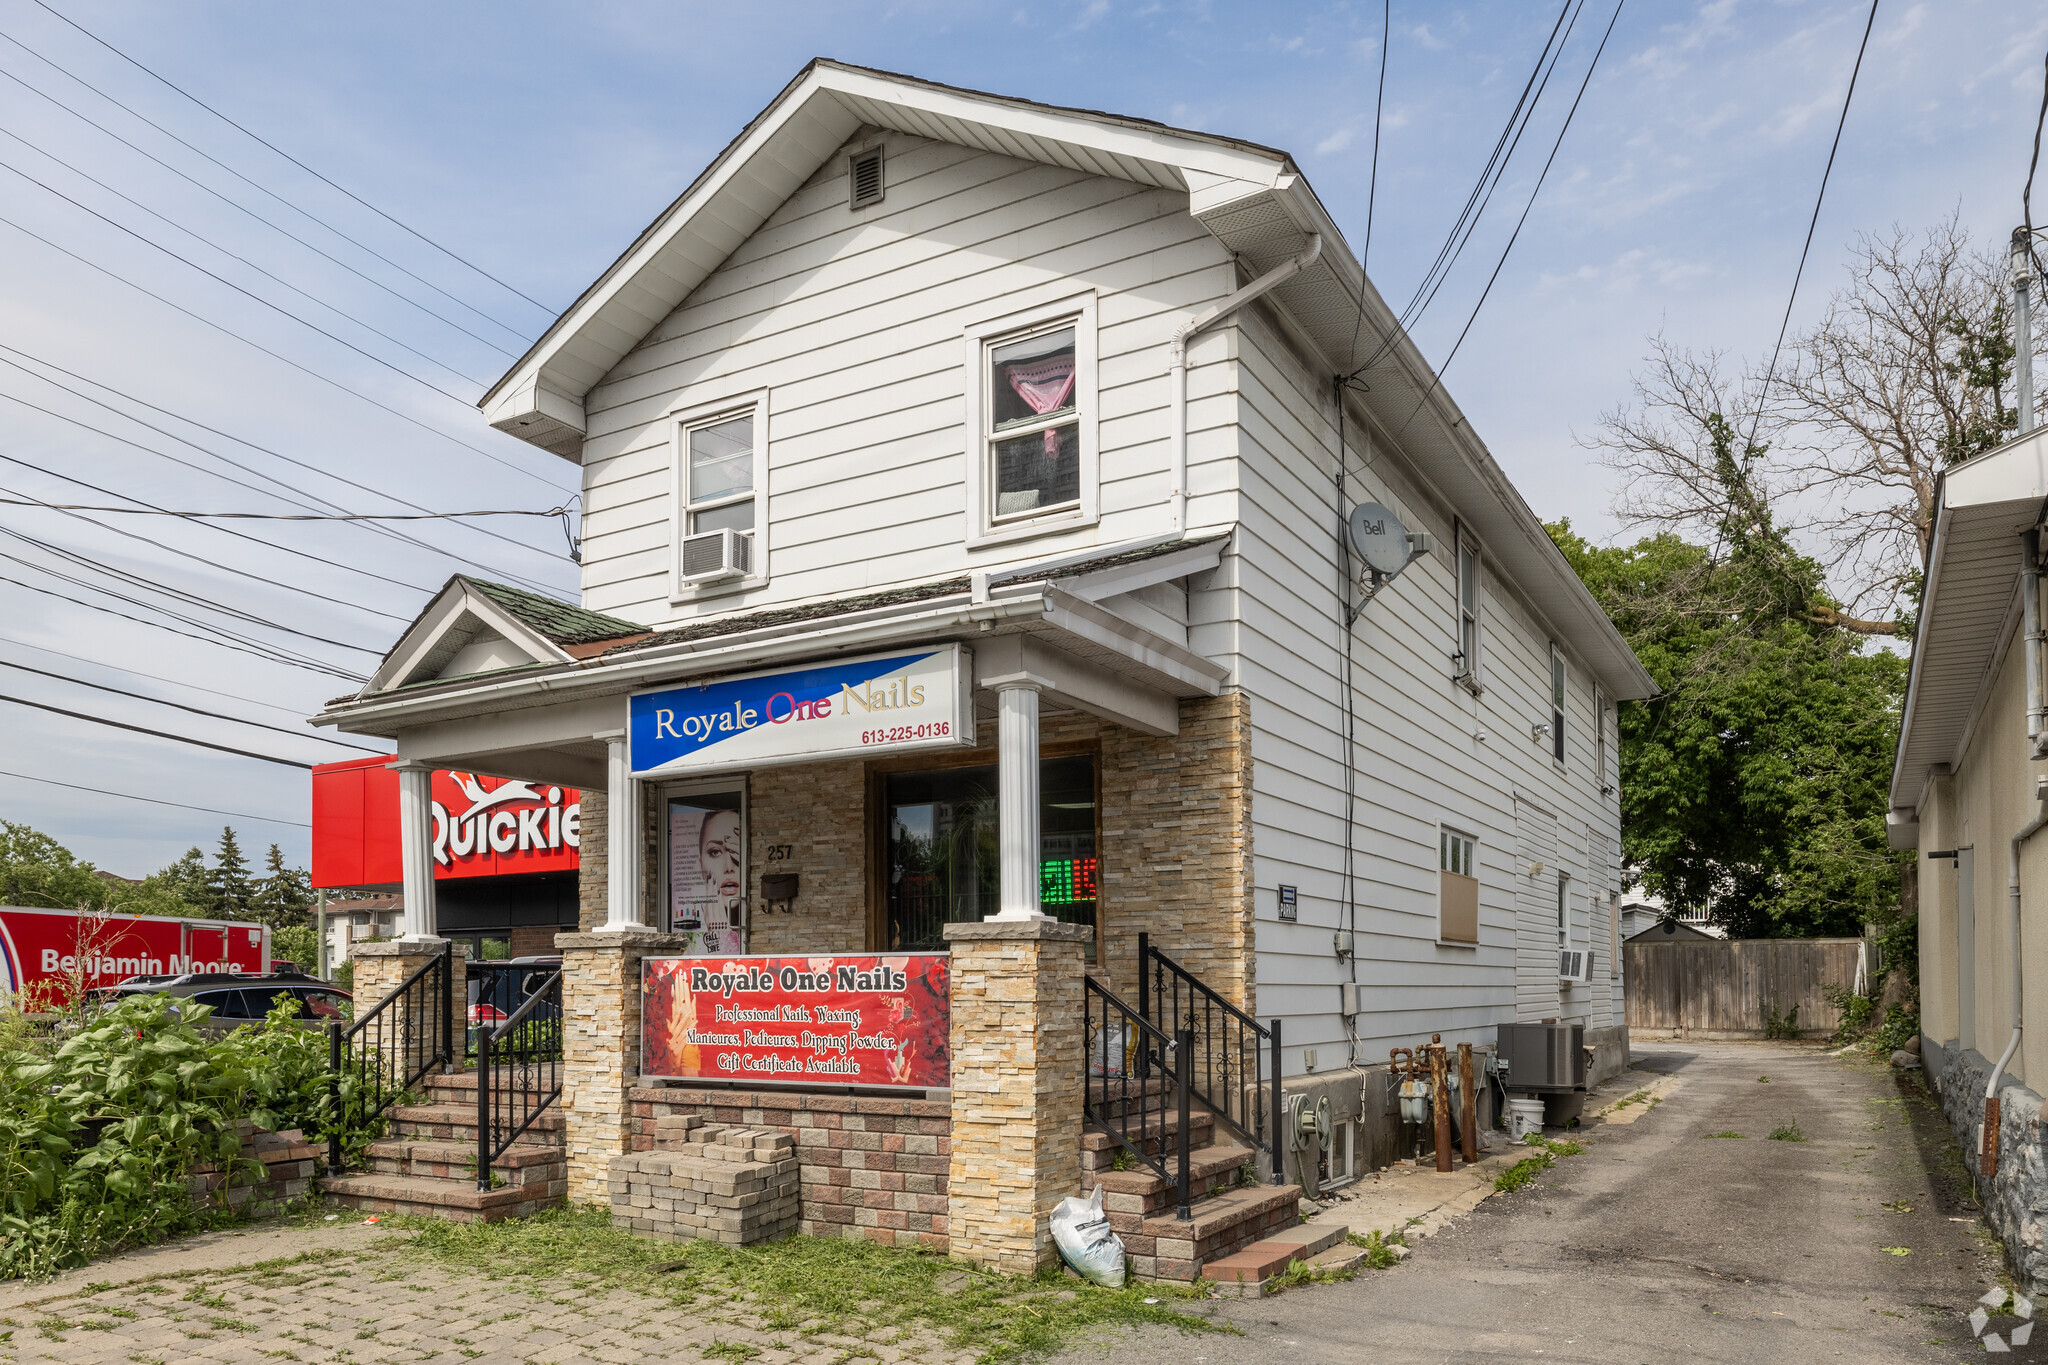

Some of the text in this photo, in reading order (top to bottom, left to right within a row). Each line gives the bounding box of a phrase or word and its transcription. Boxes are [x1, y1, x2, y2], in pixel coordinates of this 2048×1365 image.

[1363, 520, 1386, 535] Bell
[655, 676, 925, 742] Royale One Nails
[861, 721, 949, 744] 613-225-0136
[767, 845, 792, 860] 257
[169, 954, 242, 974] Moore
[690, 966, 907, 998] Royale One Nails
[715, 1003, 862, 1029] Professional Nails, Waxing,
[686, 1028, 897, 1054] Manicures, Pedicures, Dipping Powder,
[717, 1053, 860, 1074] Gift Certificate Available
